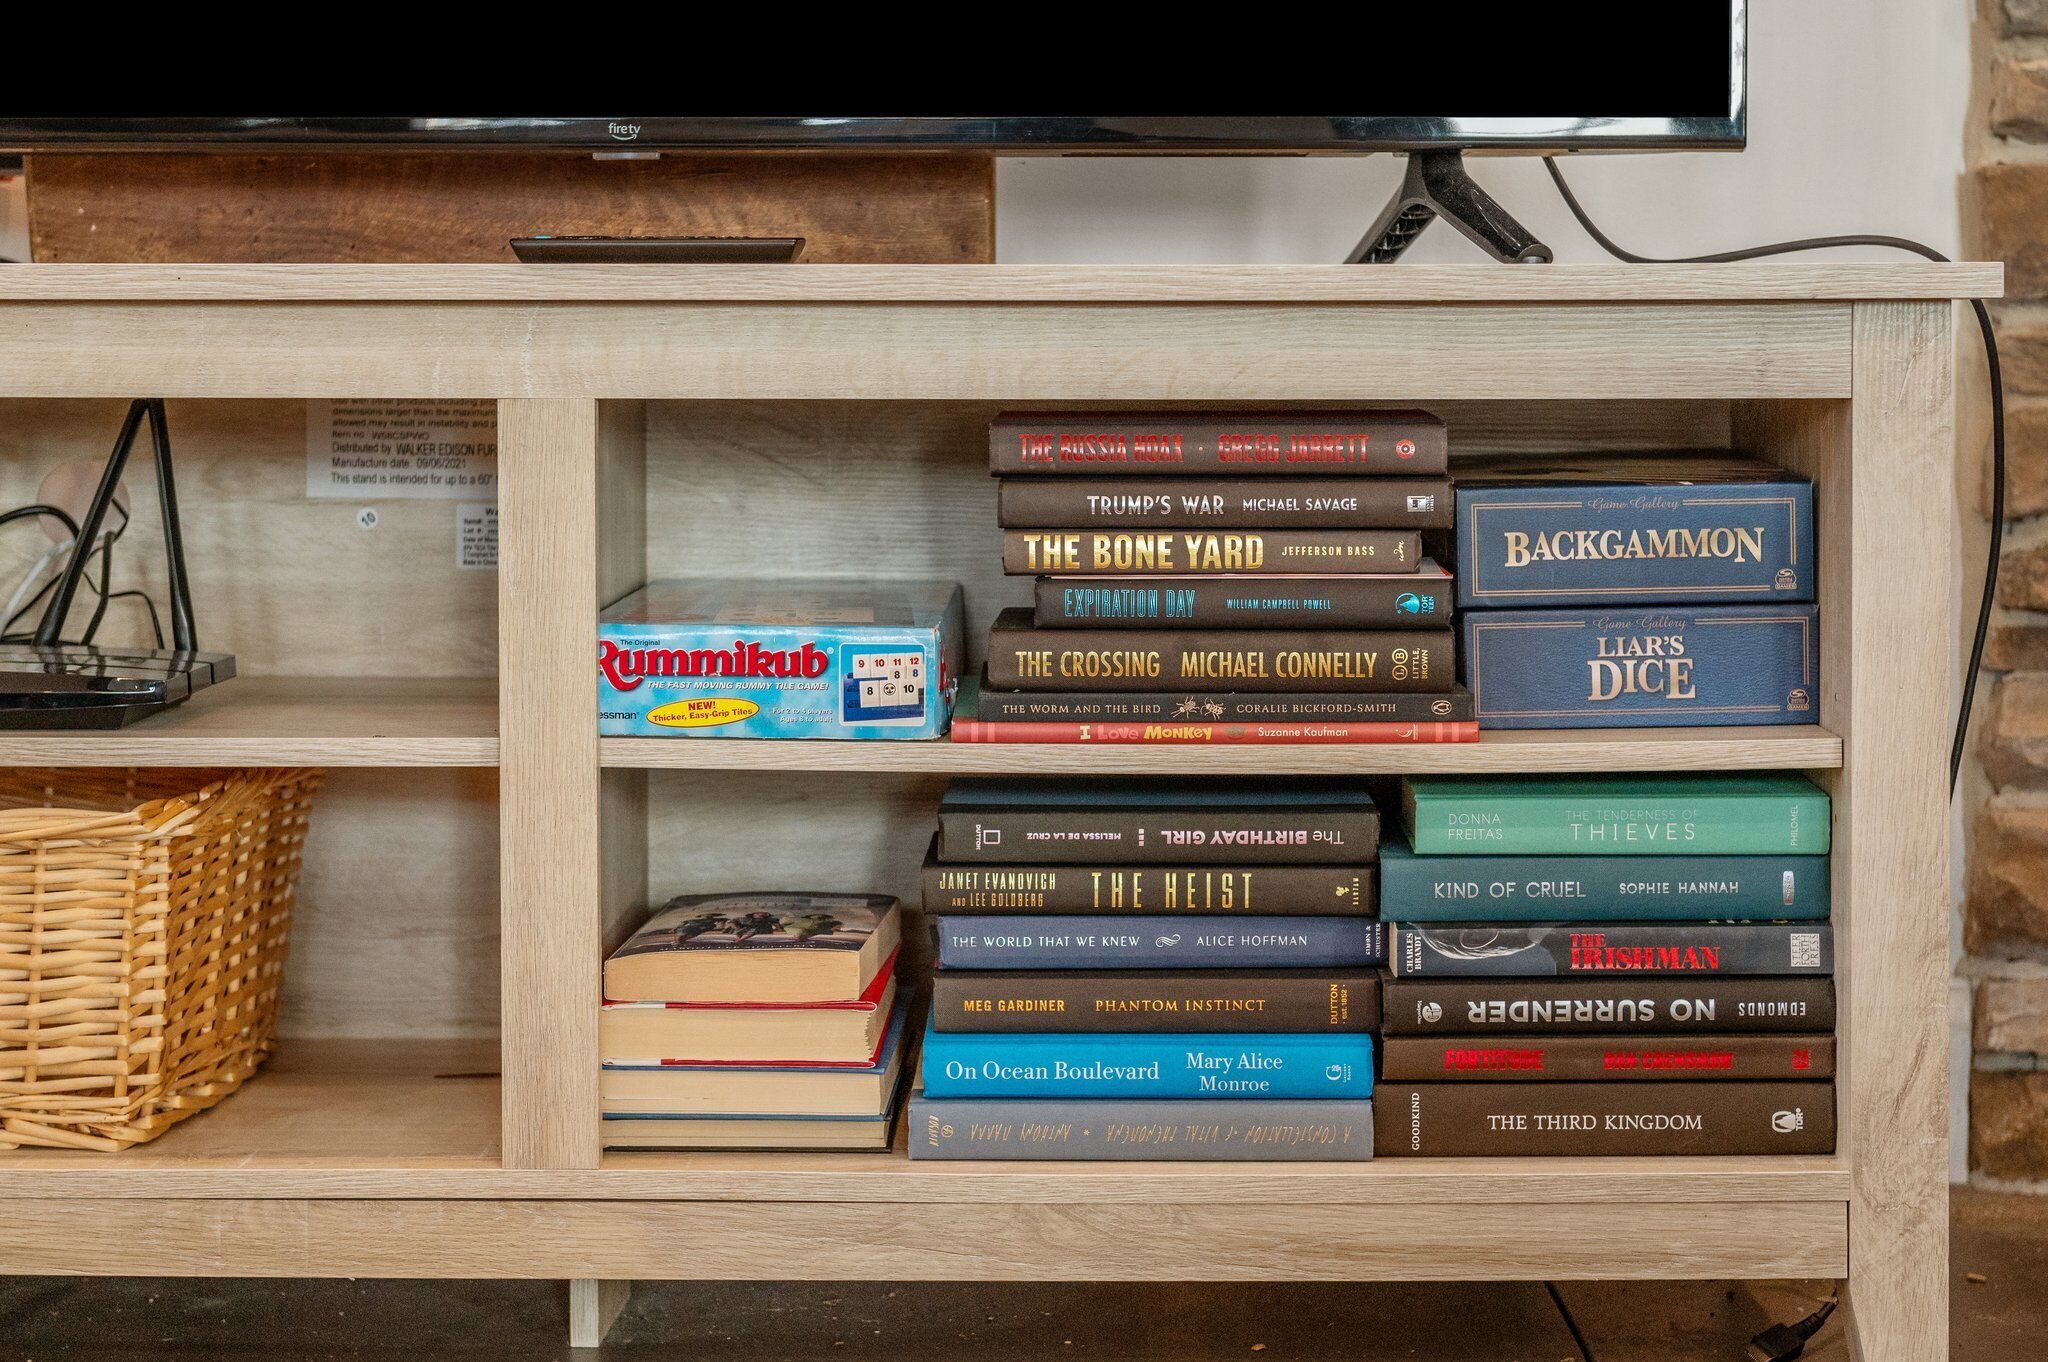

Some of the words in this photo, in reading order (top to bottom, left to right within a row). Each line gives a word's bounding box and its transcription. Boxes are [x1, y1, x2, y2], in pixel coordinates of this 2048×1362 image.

[396, 443, 436, 455] WALKER
[439, 443, 475, 456] EDISON
[1019, 434, 1054, 462] THE
[1060, 434, 1128, 462] RUSSIA
[1134, 434, 1185, 462] HOAX
[1218, 434, 1280, 463] GREGG
[1285, 434, 1370, 463] JARRETT
[332, 472, 350, 484] This
[352, 473, 377, 484] stand
[390, 473, 429, 485] intended
[1087, 495, 1171, 515] TRUMP'S
[1181, 495, 1225, 515] WAR
[1243, 498, 1300, 511] MICHAEL
[1306, 498, 1358, 511] SAVAGE
[1588, 497, 1627, 513] Game
[1630, 496, 1679, 512] Gallery
[1024, 534, 1080, 569] THE
[1093, 534, 1174, 569] BONE
[1185, 534, 1264, 569] YARD
[1281, 546, 1342, 556] JEFFERSON
[1348, 546, 1375, 556] BASS
[1504, 527, 1765, 567] BACKGAMMON
[1064, 589, 1158, 617] EXPIRATION
[1166, 589, 1196, 617] DAY
[1227, 599, 1259, 609] WILLIAM
[1263, 599, 1300, 610] CAMPBELL
[1303, 599, 1332, 610] POWELL
[1593, 617, 1632, 631] Game
[1636, 616, 1686, 630] Gallery
[634, 639, 660, 647] Original
[1597, 635, 1684, 657] LIAR'S
[858, 659, 865, 668] 9
[874, 659, 885, 667] 10
[909, 657, 920, 665] 12
[1015, 651, 1053, 677] THE
[1060, 651, 1160, 677] CROSSING
[1181, 651, 1269, 678] MICHAEL
[1275, 652, 1377, 678] CONNELLY
[1412, 647, 1421, 679] LITTLE,
[1421, 649, 1429, 680] BROWN
[894, 671, 900, 679] 8
[912, 669, 919, 677] 8
[1587, 657, 1696, 701] DICE
[647, 681, 666, 689] THE
[735, 682, 773, 690] RUMMY
[775, 682, 796, 690] TILE
[797, 682, 830, 691] GAME!
[866, 687, 874, 695] 8
[903, 685, 914, 693] 10
[687, 701, 716, 711] NEW!
[808, 708, 833, 716] players
[1003, 705, 1025, 713] THE
[1030, 705, 1069, 713] WORM
[1074, 705, 1100, 713] AND
[1105, 705, 1128, 713] THE
[1133, 705, 1161, 713] BIRD
[1236, 704, 1288, 713] CORALIE
[1292, 703, 1396, 713] BICKFORD-SMITH
[653, 714, 687, 723] Thicker,
[689, 711, 730, 720] Easy-Grip
[732, 708, 753, 716] Tiles
[1079, 725, 1091, 740] I
[1258, 727, 1300, 737] Suzanne
[1304, 727, 1348, 737] Kaufman
[1449, 813, 1502, 825] DONNA
[1565, 810, 1589, 821] THE
[1597, 809, 1677, 821] TENDERNESS
[1682, 809, 1698, 820] OF
[1571, 823, 1695, 841] THIEVES
[1790, 804, 1798, 846] PHILOMEL
[1026, 832, 1051, 840] CRUZ
[1053, 832, 1066, 840] LA
[1068, 832, 1080, 840] DE
[1083, 832, 1121, 840] MELISSA
[1161, 830, 1206, 845] GIRL
[1210, 830, 1307, 845] BIRTHDAY
[1313, 830, 1344, 845] The
[1448, 829, 1503, 840] FREITAS
[939, 873, 978, 890] JANET
[985, 873, 1056, 890] EVANOVICH
[1092, 872, 1142, 908] THE
[1165, 872, 1253, 908] HEIST
[1434, 882, 1479, 899] KIND
[1490, 882, 1516, 898] OF
[1526, 881, 1586, 898] CRUEL
[1619, 882, 1670, 895] SOPHIE
[1678, 882, 1739, 894] HANNAH
[952, 898, 966, 907] AND
[970, 893, 986, 907] LEE
[991, 893, 1044, 907] GOLDBERG
[953, 936, 977, 947] THE
[983, 936, 1032, 947] WORLD
[1038, 936, 1070, 947] THAT
[1076, 936, 1096, 947] WE
[1102, 936, 1140, 947] KNEW
[1196, 935, 1235, 946] ALICE
[1241, 935, 1308, 946] HOFFMAN
[1570, 934, 1606, 947] THE
[1792, 935, 1801, 966] STEER
[1801, 935, 1810, 966] FORTH
[1810, 935, 1819, 966] PRESS
[1570, 947, 1720, 970] IRISHMAN
[963, 1000, 992, 1012] MEG
[998, 1000, 1065, 1012] GARDINER
[1095, 1000, 1178, 1012] PHANTOM
[1186, 1000, 1266, 1012] INSTINCT
[1330, 983, 1338, 1025] DUTTON
[1468, 1000, 1655, 1023] SURRENDER
[1670, 999, 1715, 1022] NO
[1738, 1002, 1806, 1016] EDMONDS
[1186, 1052, 1233, 1074] Mary
[1237, 1052, 1283, 1069] Alice
[1444, 1050, 1544, 1070] FORTITUDE
[1603, 1052, 1638, 1070] DAN
[1641, 1052, 1734, 1070] CRENSHAW
[945, 1061, 977, 1080] On
[982, 1061, 1048, 1080] Ocean
[1053, 1061, 1160, 1080] Boulevard
[1199, 1076, 1270, 1091] Monroe
[1412, 1092, 1420, 1150] GOODKIND
[1487, 1115, 1527, 1130] THE
[1534, 1115, 1597, 1130] THIRD
[1604, 1115, 1702, 1130] KINGDOM
